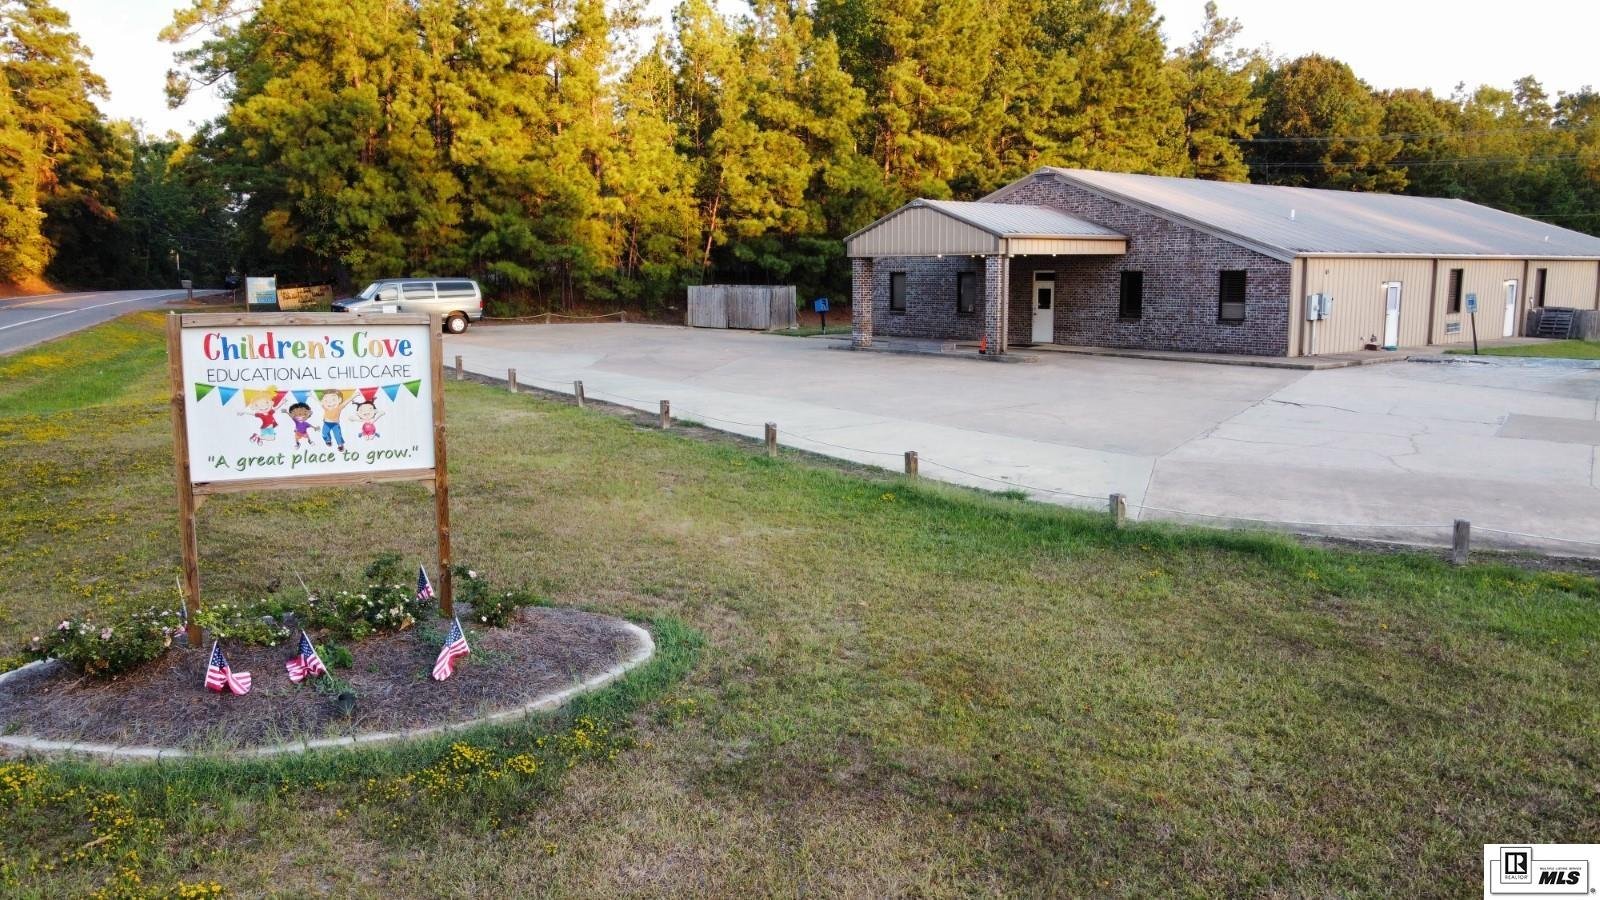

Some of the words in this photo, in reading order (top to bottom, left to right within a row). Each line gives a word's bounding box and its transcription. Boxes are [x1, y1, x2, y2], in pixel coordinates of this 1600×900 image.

[204, 332, 344, 360] Children's
[352, 331, 412, 358] Cove
[207, 366, 322, 383] EDUCATIONAL
[327, 364, 412, 379] CHILDCARE
[236, 454, 284, 471] great
[291, 450, 336, 469] place
[342, 449, 359, 462] to
[366, 445, 419, 464] grow."
